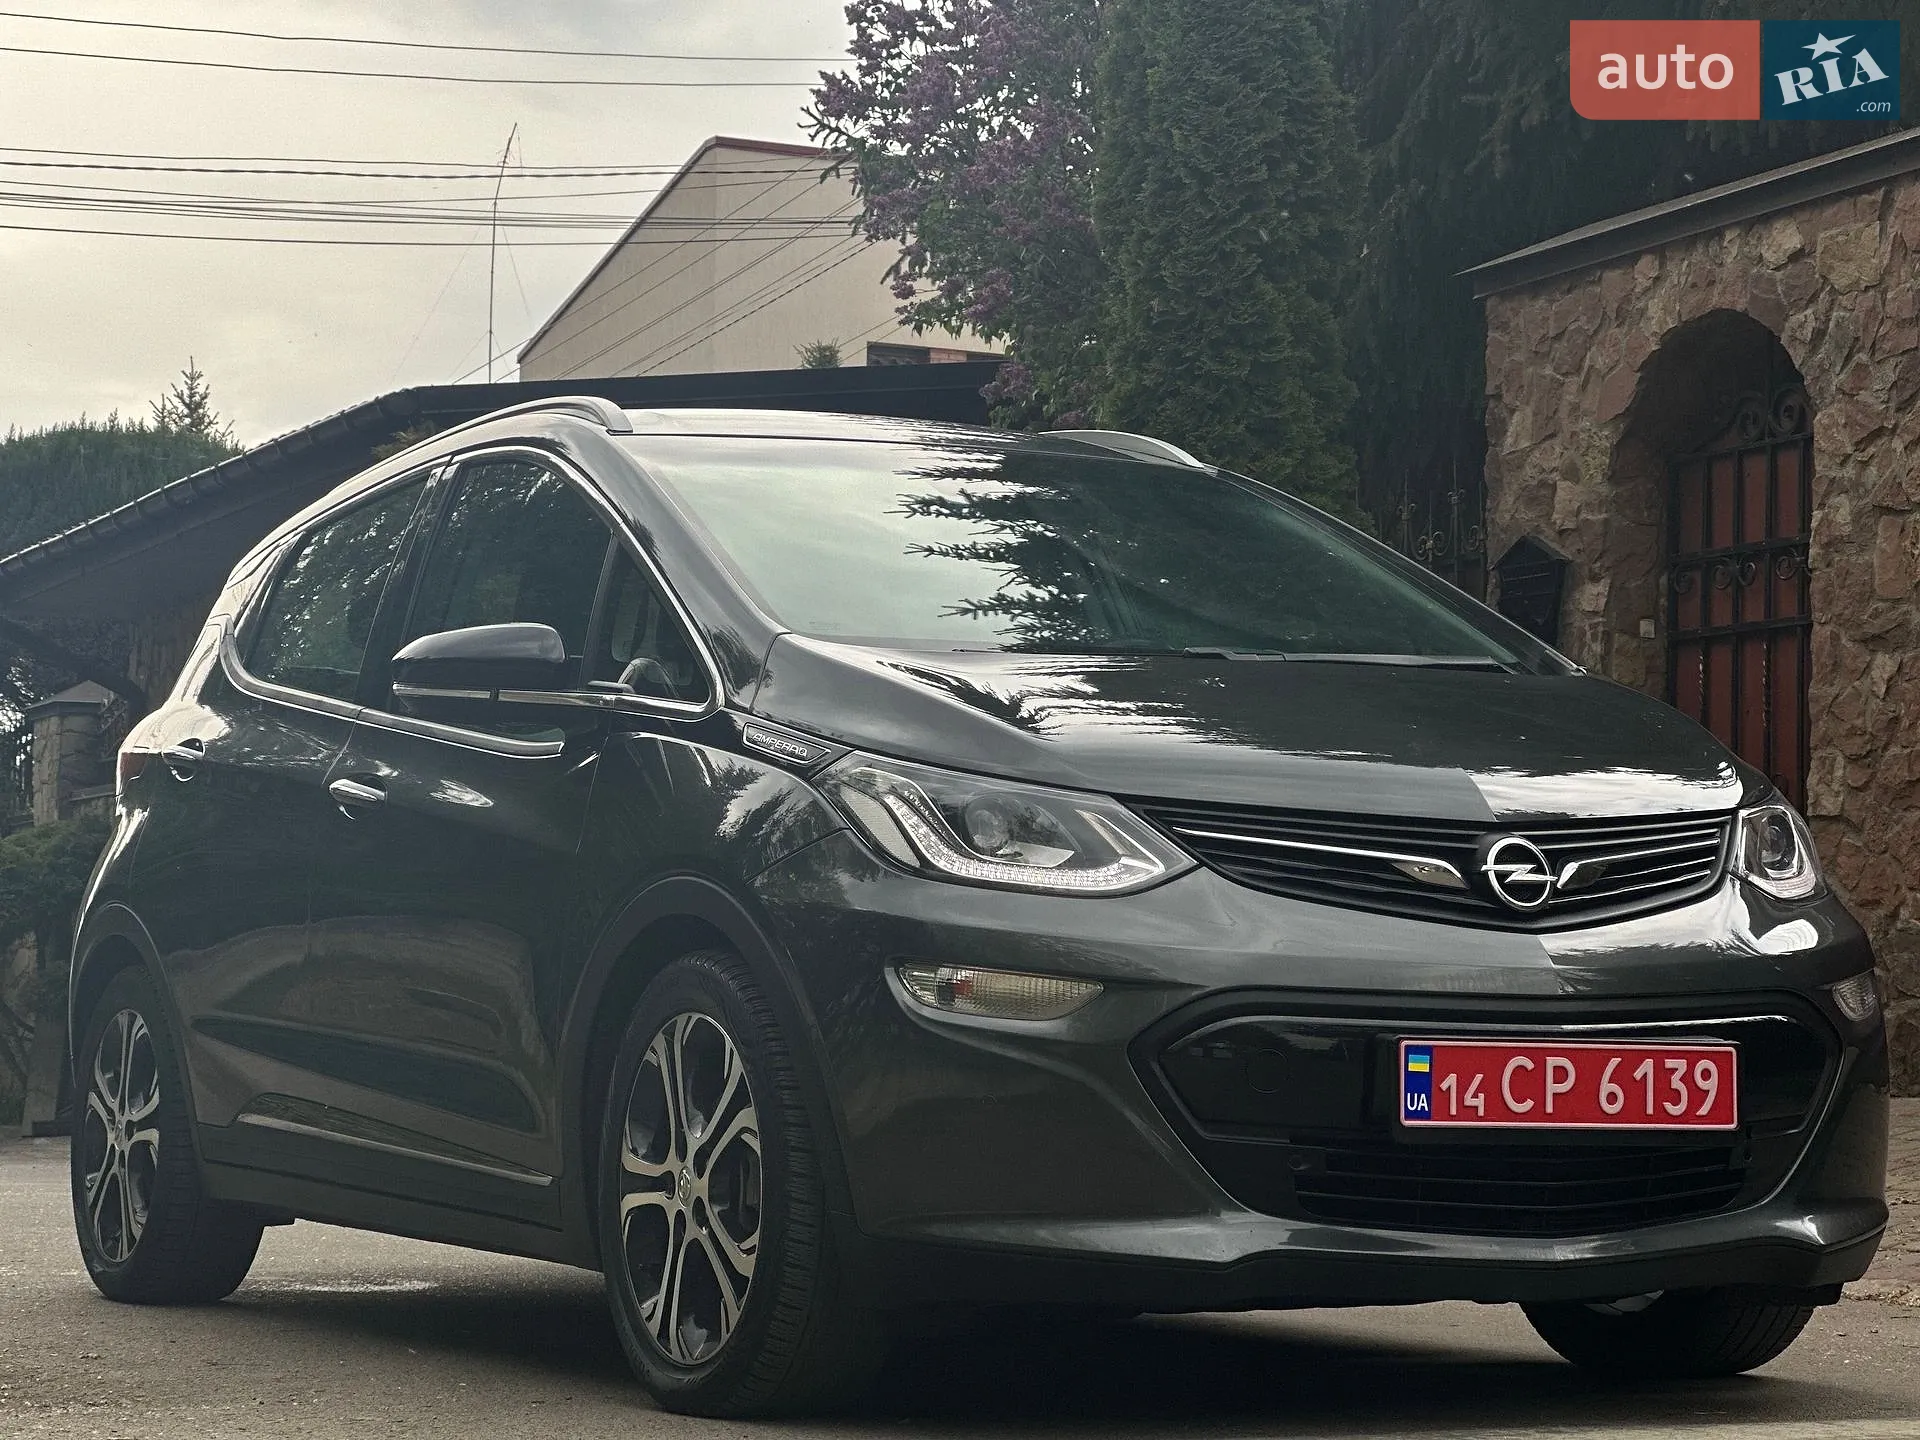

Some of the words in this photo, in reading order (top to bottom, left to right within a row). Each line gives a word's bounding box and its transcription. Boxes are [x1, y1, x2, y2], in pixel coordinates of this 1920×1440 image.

[1407, 1093, 1429, 1112] UA
[1439, 1073, 1485, 1117] 14
[1501, 1056, 1576, 1114] CP
[1599, 1057, 1719, 1116] 6139
